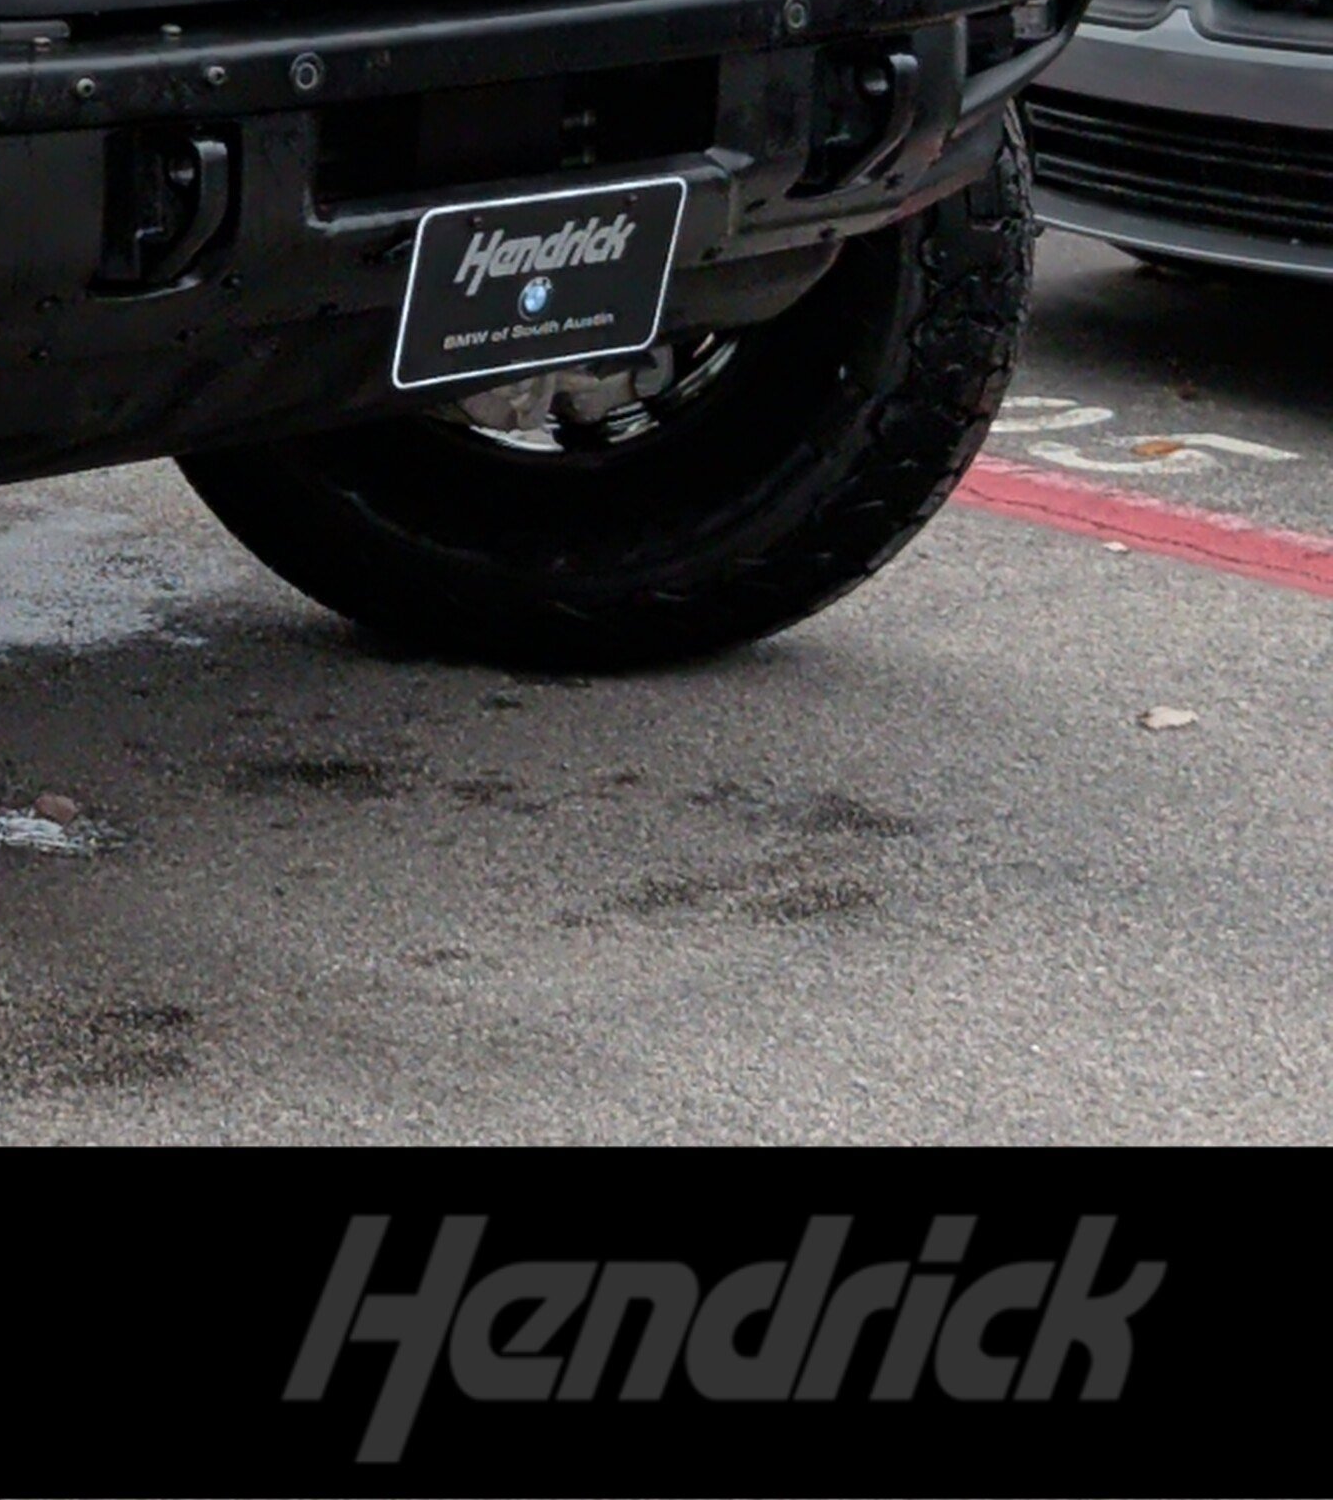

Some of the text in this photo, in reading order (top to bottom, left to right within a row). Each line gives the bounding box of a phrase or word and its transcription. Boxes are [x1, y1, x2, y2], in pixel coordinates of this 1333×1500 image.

[453, 213, 636, 297] Hendrick
[443, 312, 615, 350] BMW of South Austin
